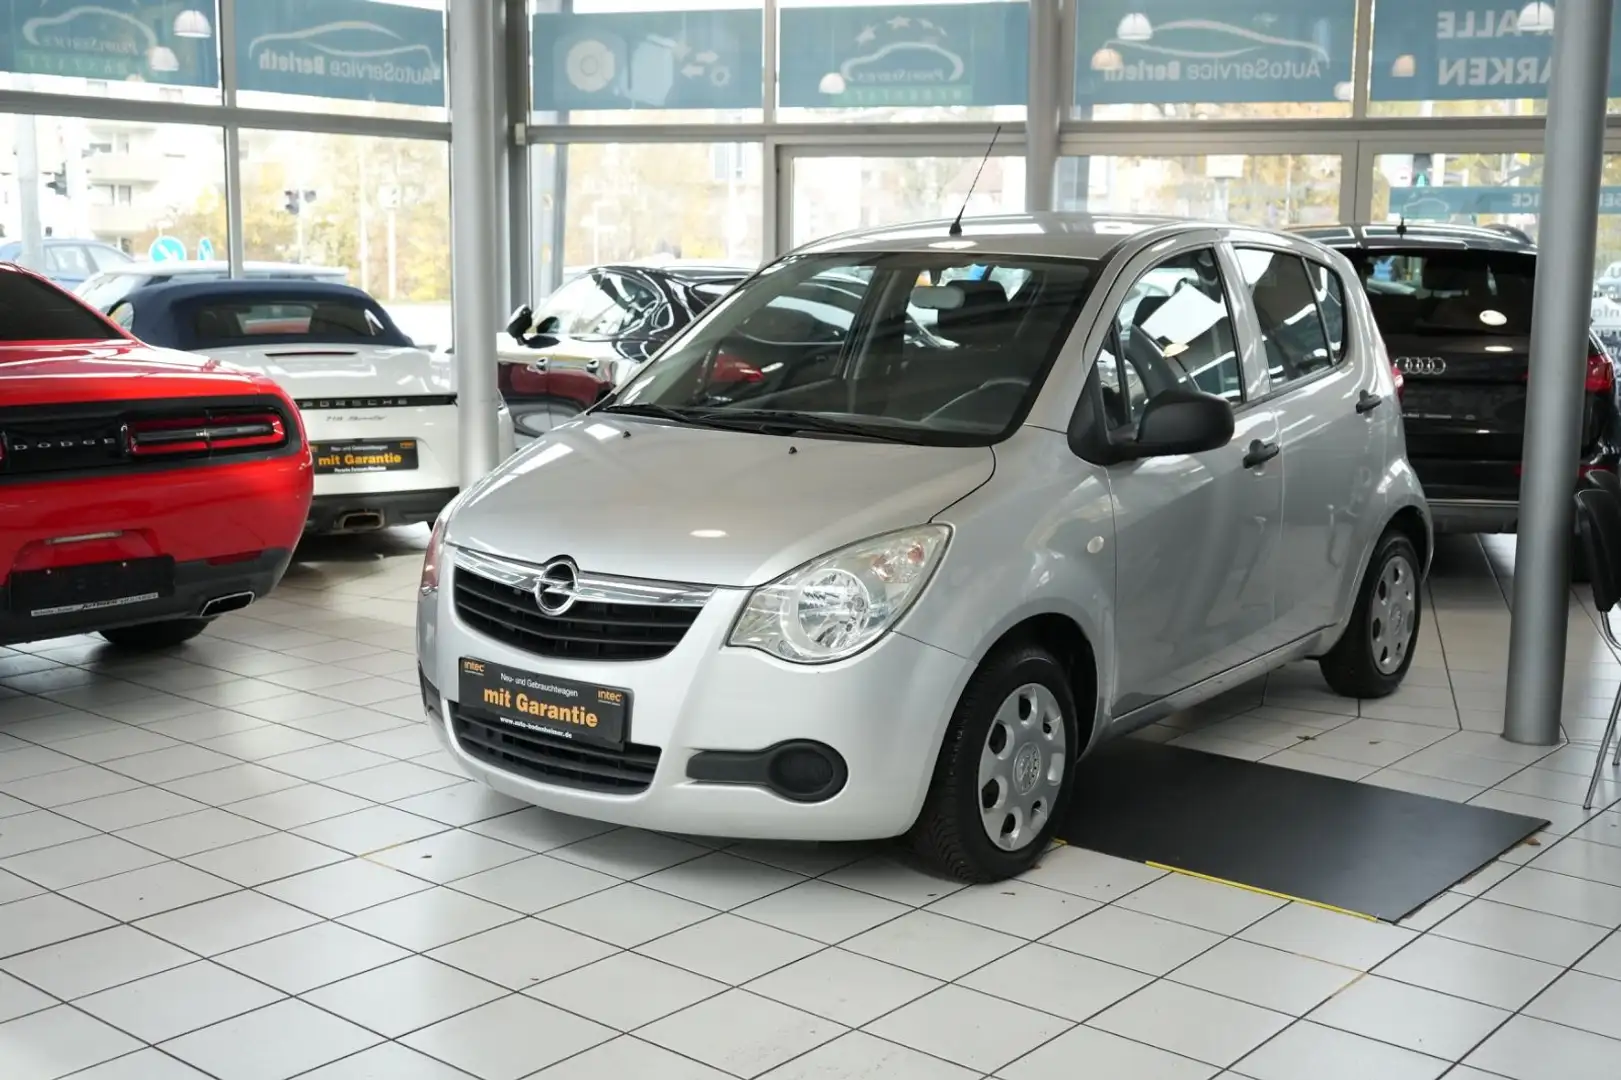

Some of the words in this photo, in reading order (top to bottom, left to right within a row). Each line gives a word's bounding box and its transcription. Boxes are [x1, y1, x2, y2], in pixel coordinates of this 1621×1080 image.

[302, 399, 407, 408] PORSCHE
[14, 438, 116, 450] DODGE
[318, 454, 341, 466] mit
[344, 452, 402, 466] Garantie
[500, 672, 514, 683] Neu-
[515, 677, 526, 686] und
[527, 678, 579, 698] Gebrauchtwagen
[483, 687, 511, 708] mit
[515, 693, 598, 728] Garantie
